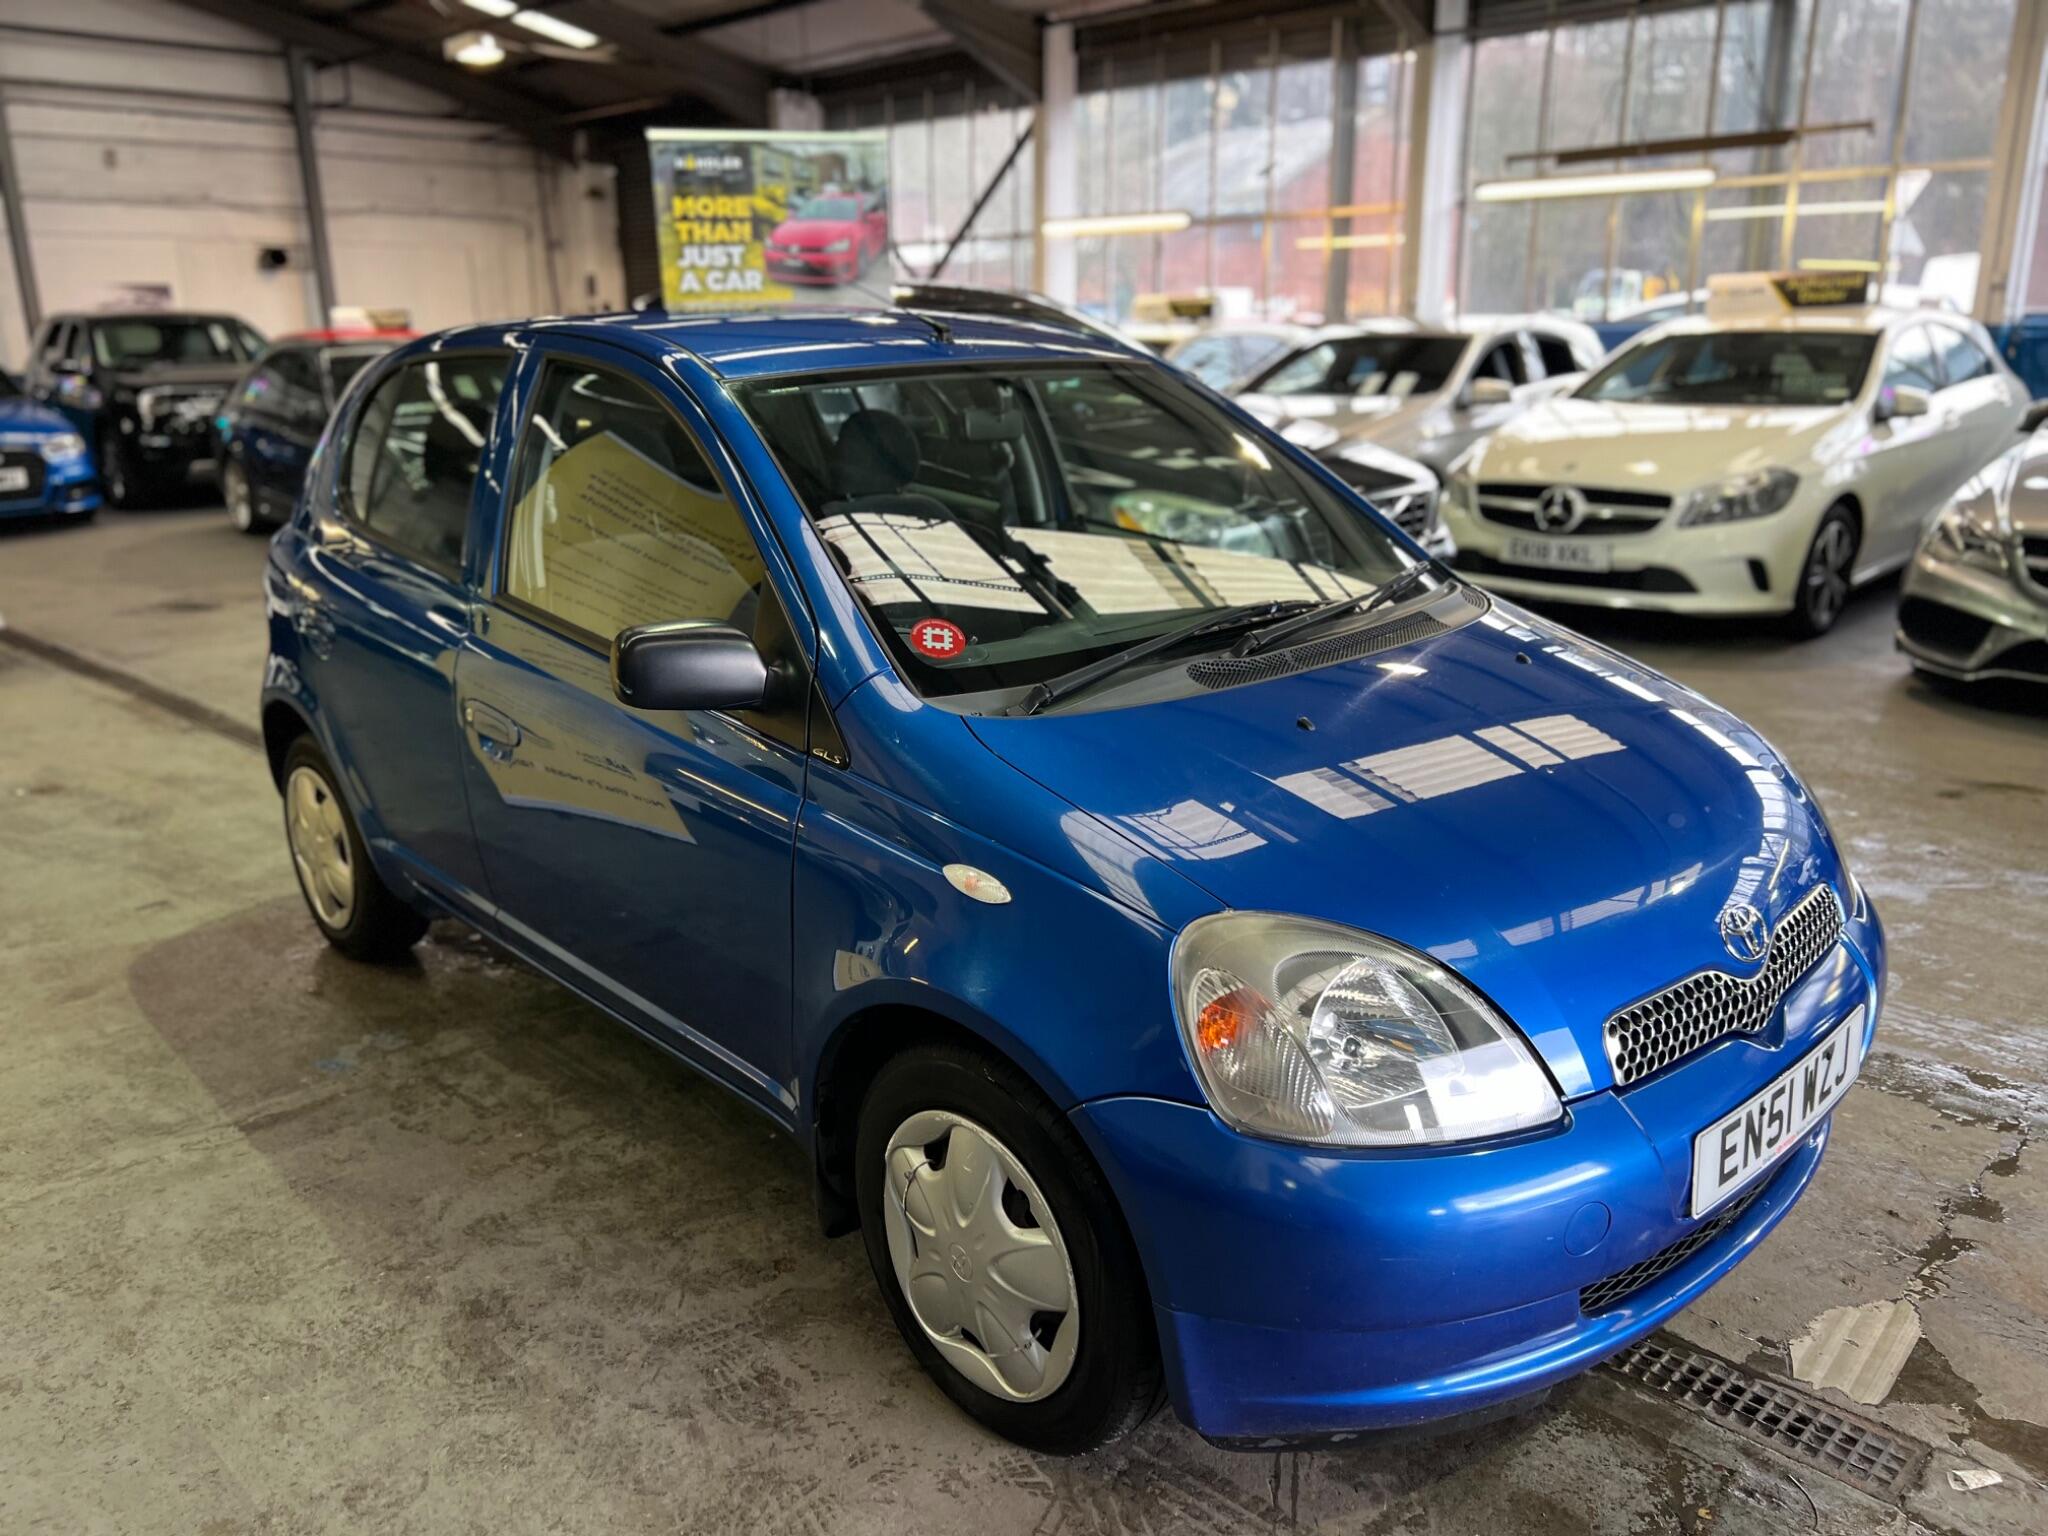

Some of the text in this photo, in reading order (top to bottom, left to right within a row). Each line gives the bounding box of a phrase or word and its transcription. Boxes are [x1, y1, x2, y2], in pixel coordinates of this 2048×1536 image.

[672, 195, 751, 218] MORE
[675, 221, 752, 243] THAN
[678, 245, 745, 267] JUST
[680, 270, 763, 292] A CAR
[812, 748, 841, 764] GLS
[1718, 1025, 1851, 1187] EN51 WZJ
